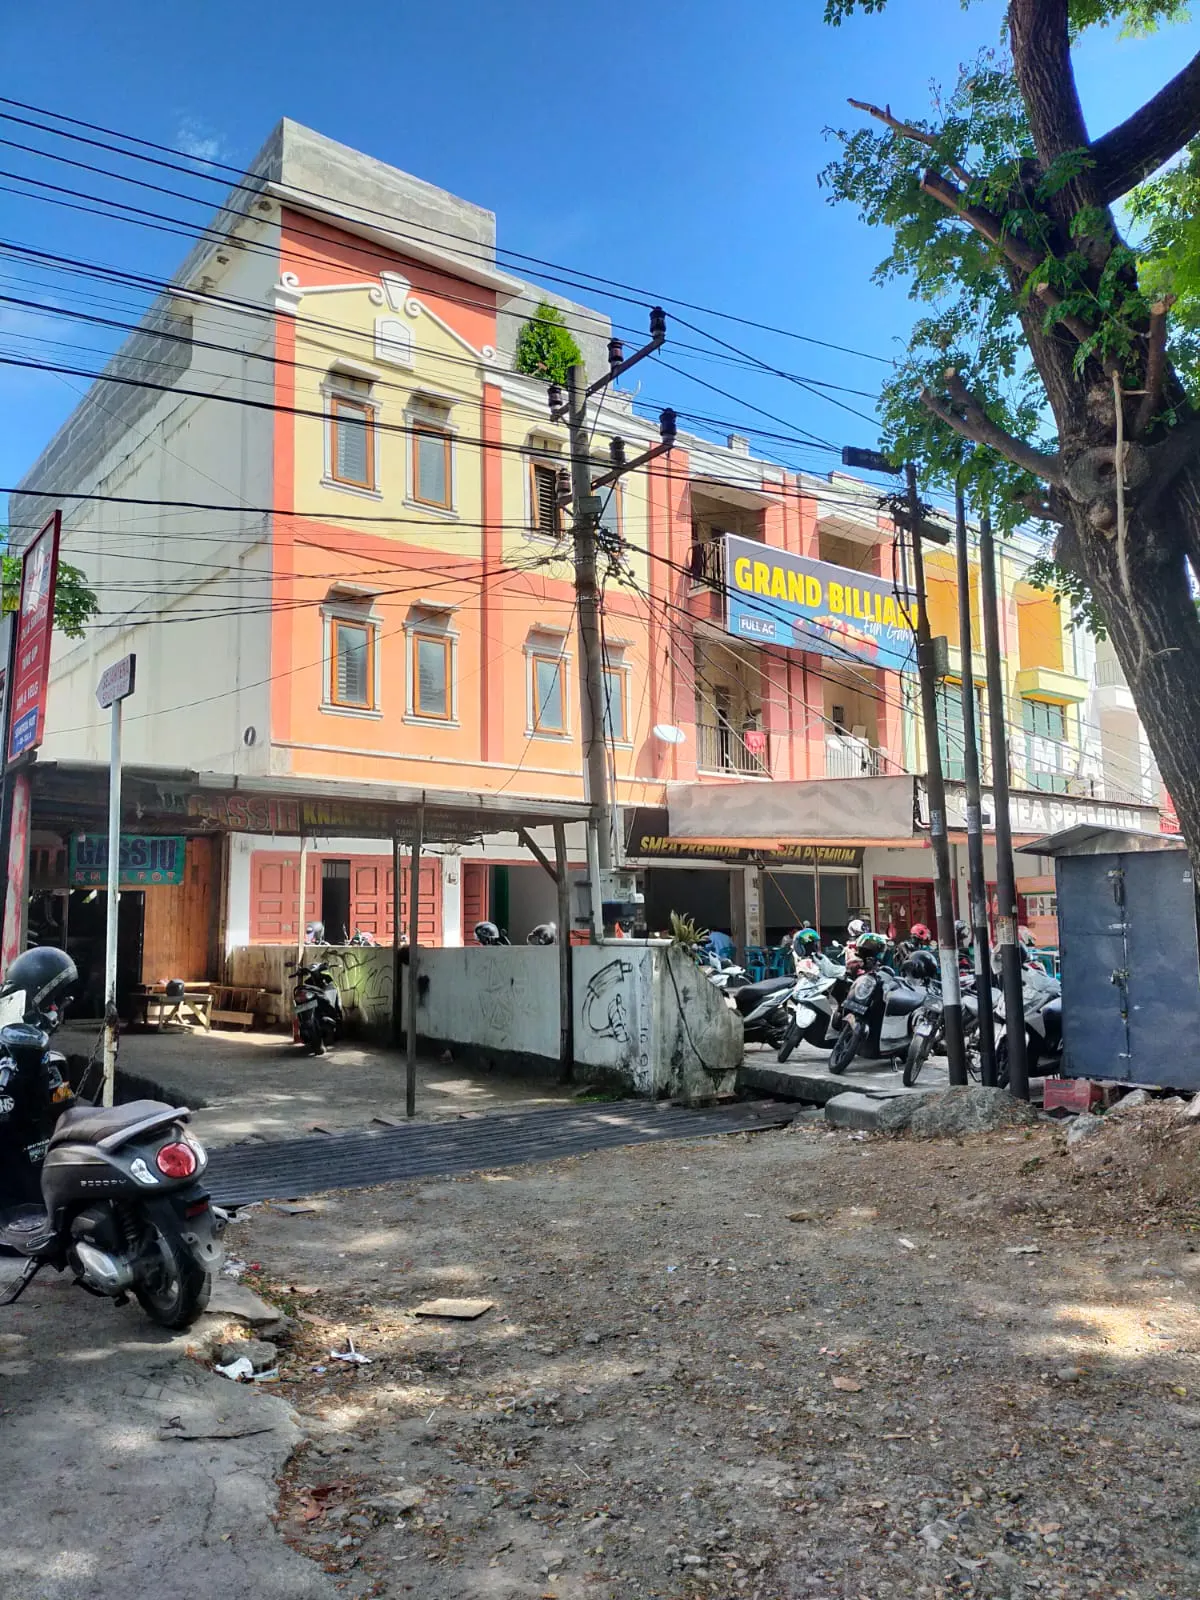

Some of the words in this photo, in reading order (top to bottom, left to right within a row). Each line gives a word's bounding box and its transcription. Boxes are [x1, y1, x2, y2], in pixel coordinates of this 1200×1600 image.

[735, 557, 822, 608] GRAND
[741, 618, 761, 633] FULL
[762, 624, 775, 636] AC
[75, 871, 176, 882] KNLPOT
